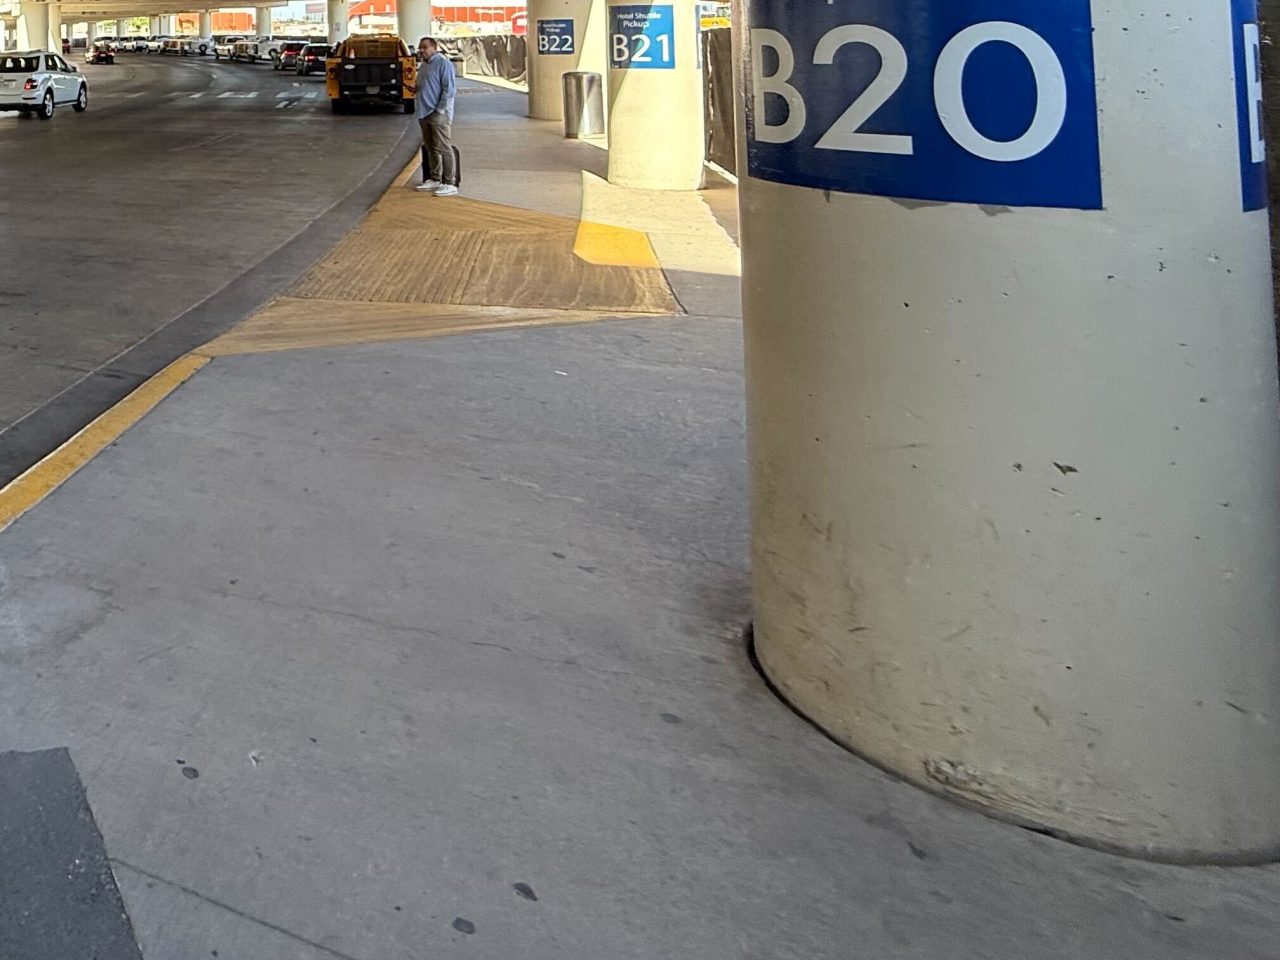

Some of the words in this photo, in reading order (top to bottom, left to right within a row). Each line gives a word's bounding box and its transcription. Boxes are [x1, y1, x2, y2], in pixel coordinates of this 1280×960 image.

[623, 20, 650, 29] Pickup
[539, 34, 573, 51] B22
[613, 34, 669, 62] B21
[751, 21, 1067, 162] B20
